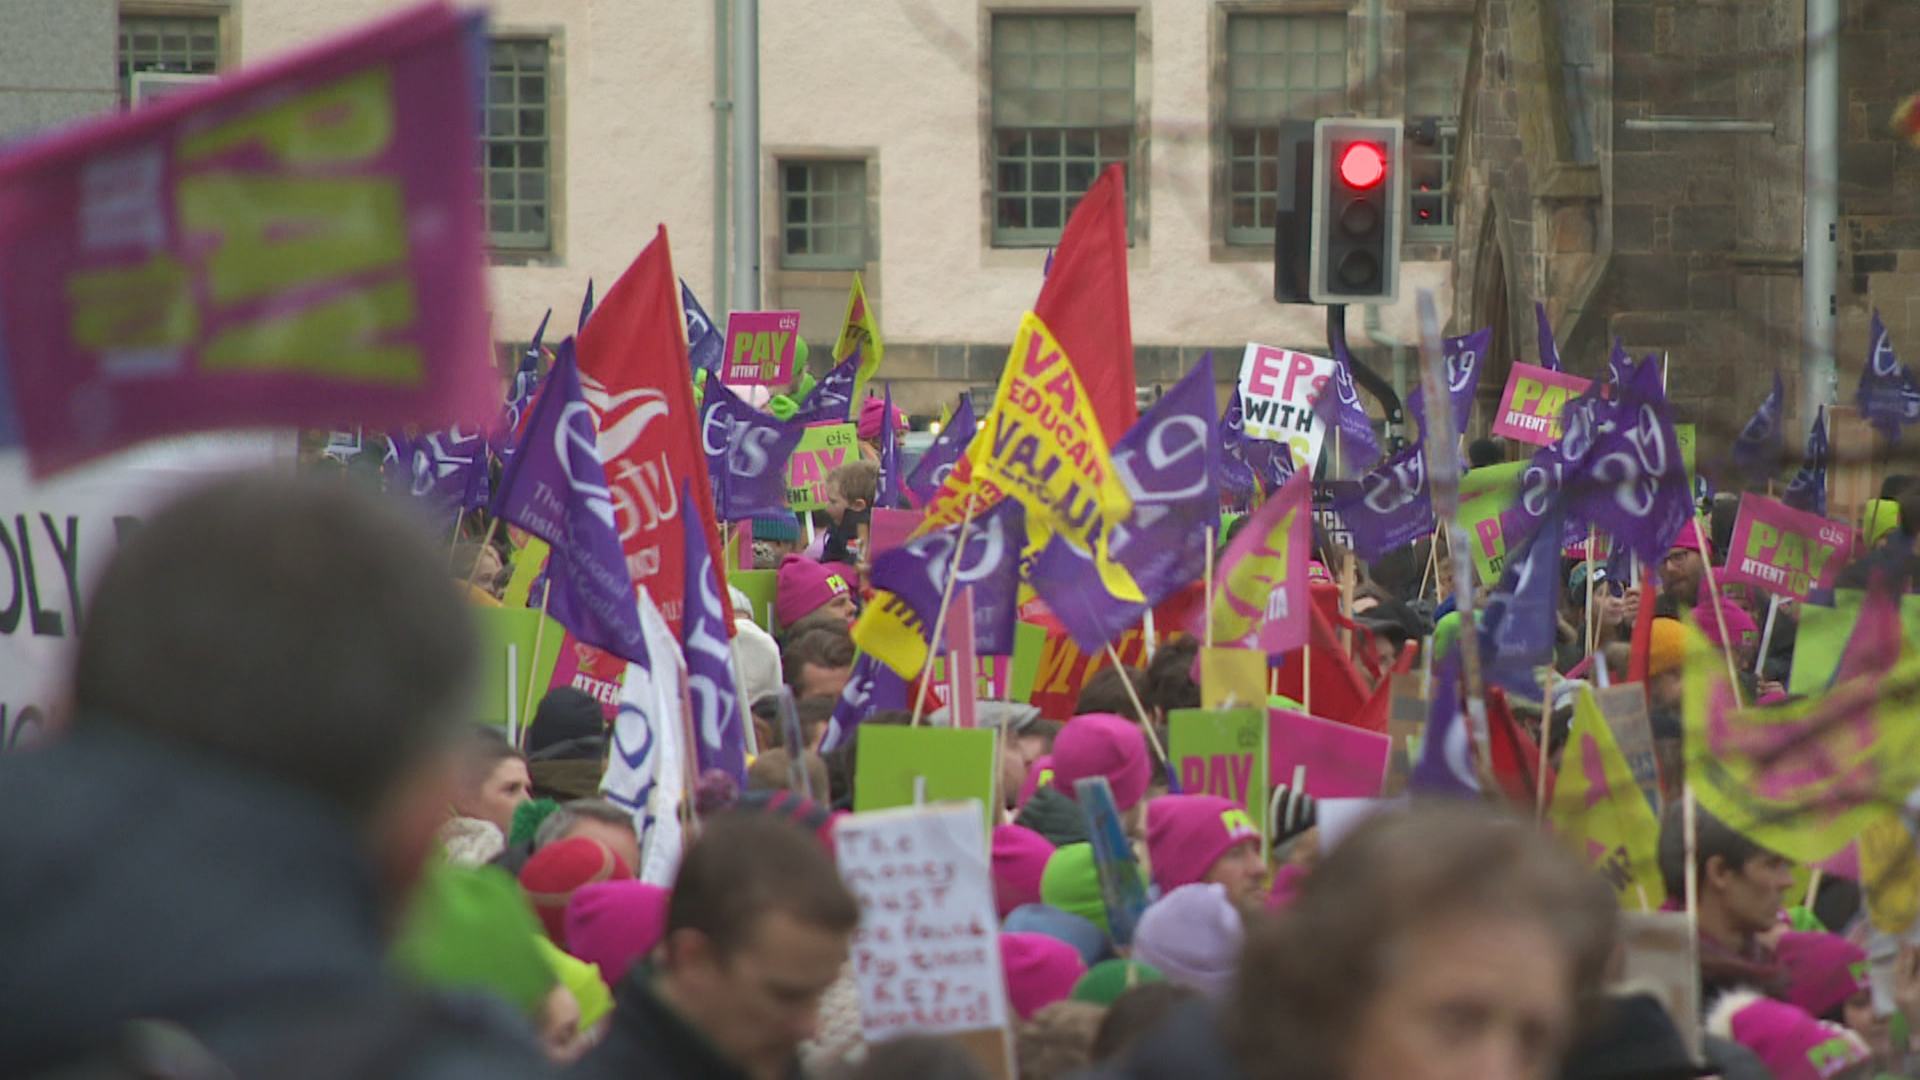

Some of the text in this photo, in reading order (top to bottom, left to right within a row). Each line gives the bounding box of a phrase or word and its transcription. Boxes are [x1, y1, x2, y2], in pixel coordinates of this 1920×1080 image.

[778, 315, 797, 330] eis
[732, 331, 791, 364] PAY
[1509, 376, 1582, 417] PA
[1244, 396, 1315, 434] WITH
[826, 430, 851, 447] eis
[1746, 519, 1836, 580] PAY
[1818, 526, 1845, 545] eis
[1181, 754, 1254, 806] PAY
